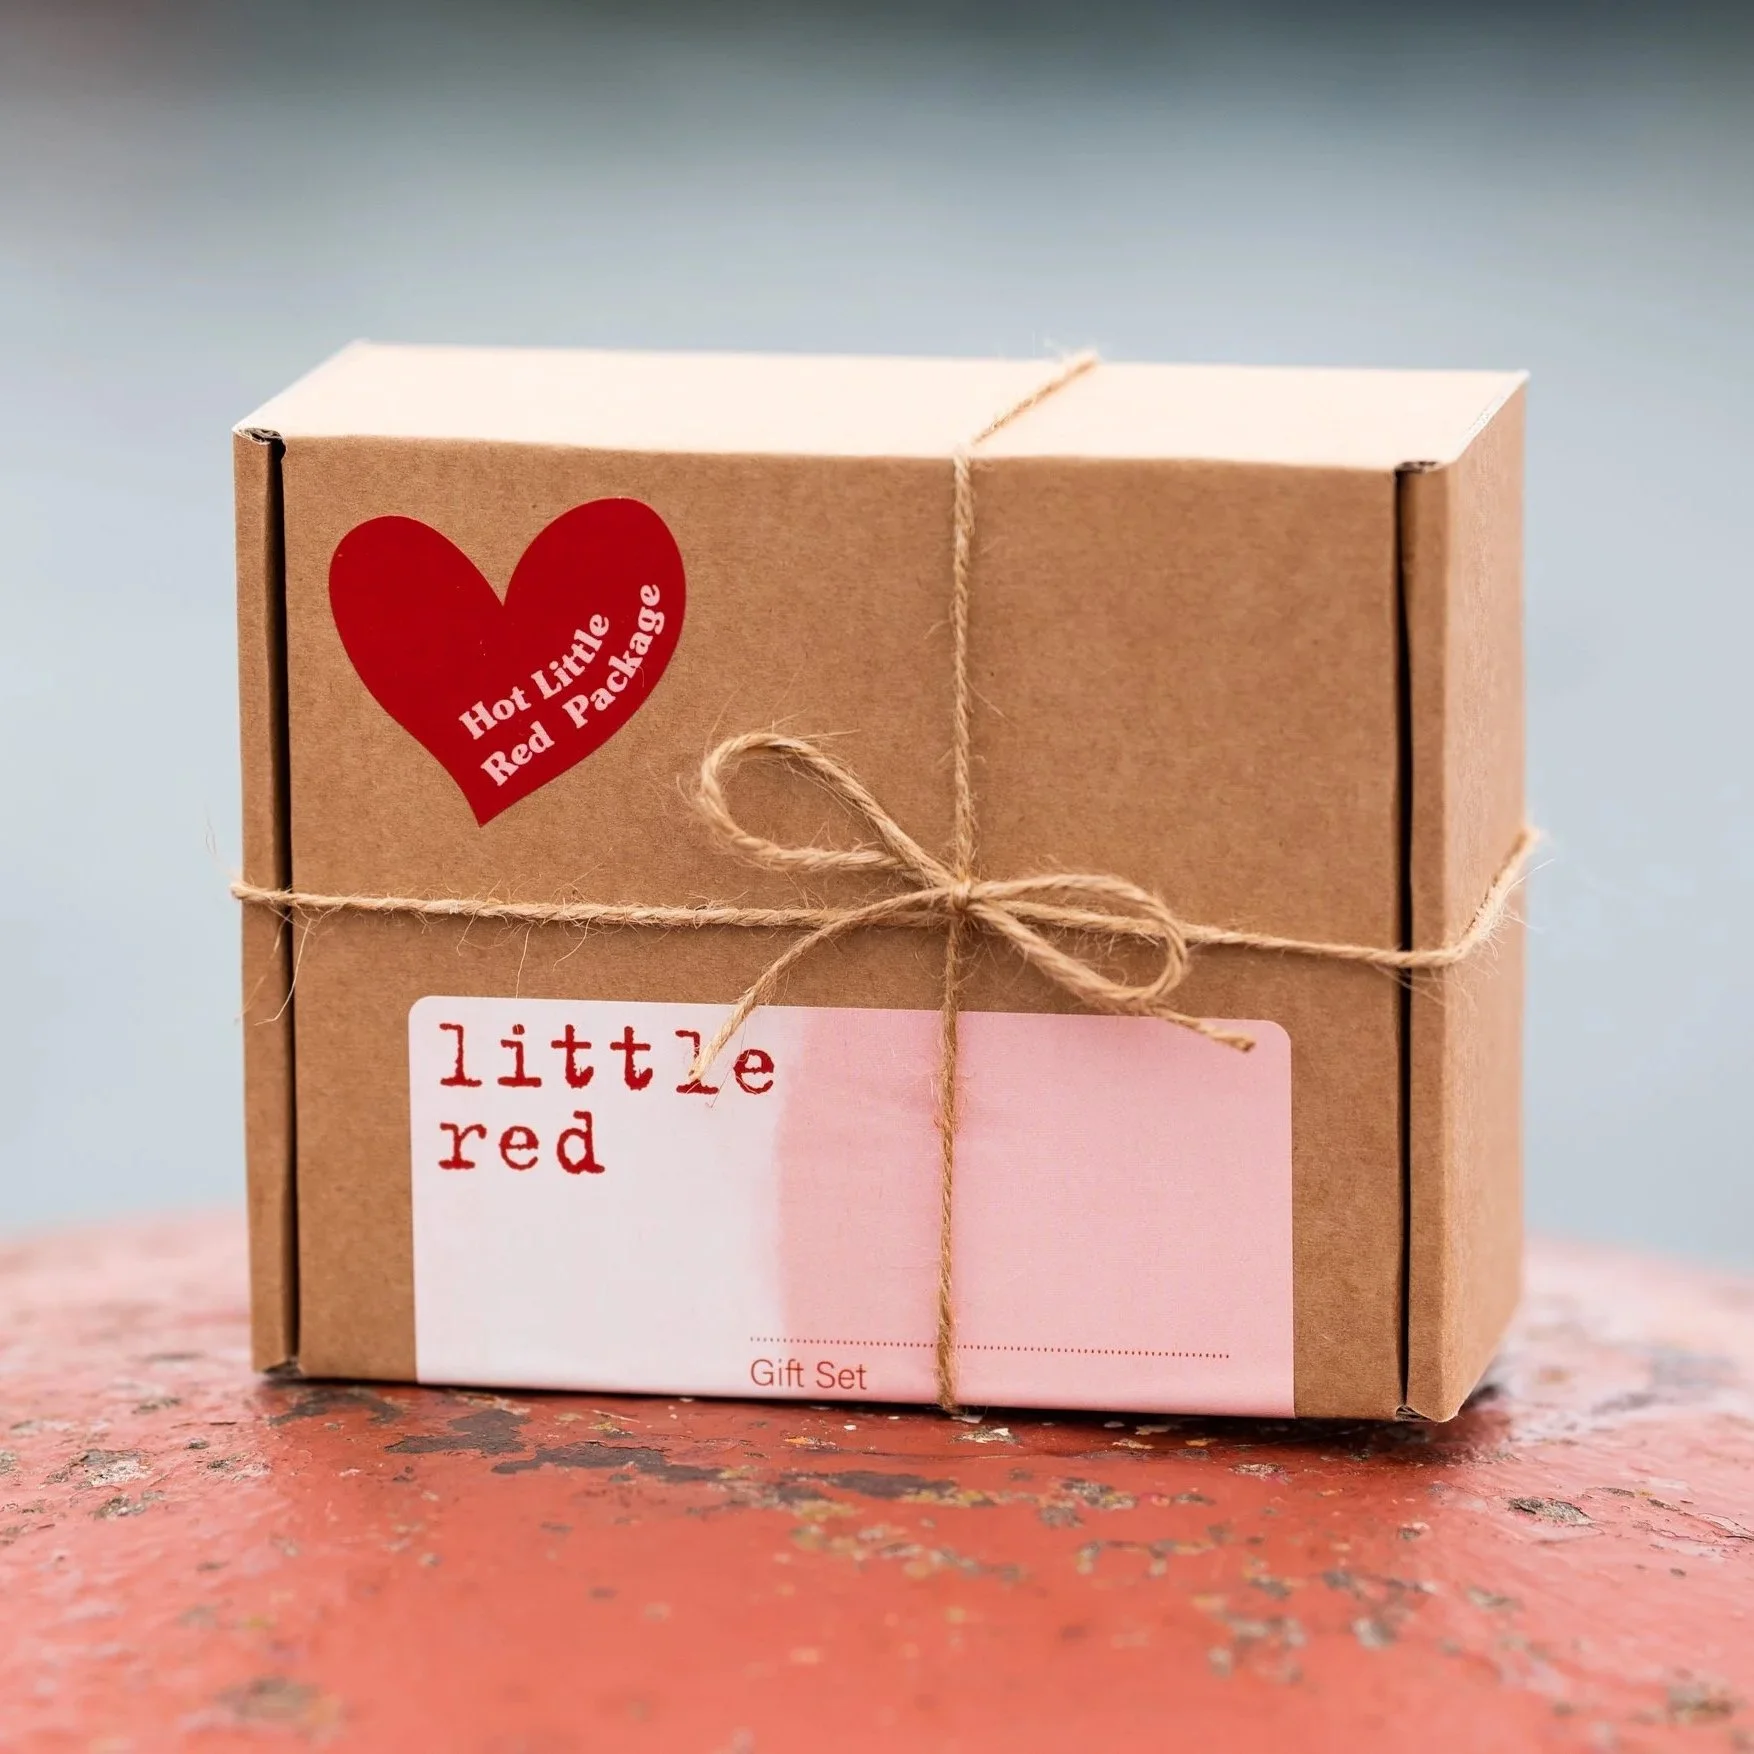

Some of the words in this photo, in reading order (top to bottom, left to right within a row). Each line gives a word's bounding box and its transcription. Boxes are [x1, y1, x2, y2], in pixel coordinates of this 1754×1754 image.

[458, 686, 532, 740] Hot
[531, 613, 610, 700] Little
[480, 720, 555, 787] Red
[561, 583, 666, 729] Package
[438, 1022, 775, 1096] little
[438, 1109, 606, 1175] red
[749, 1357, 805, 1389] Gift
[815, 1360, 868, 1391] Set
